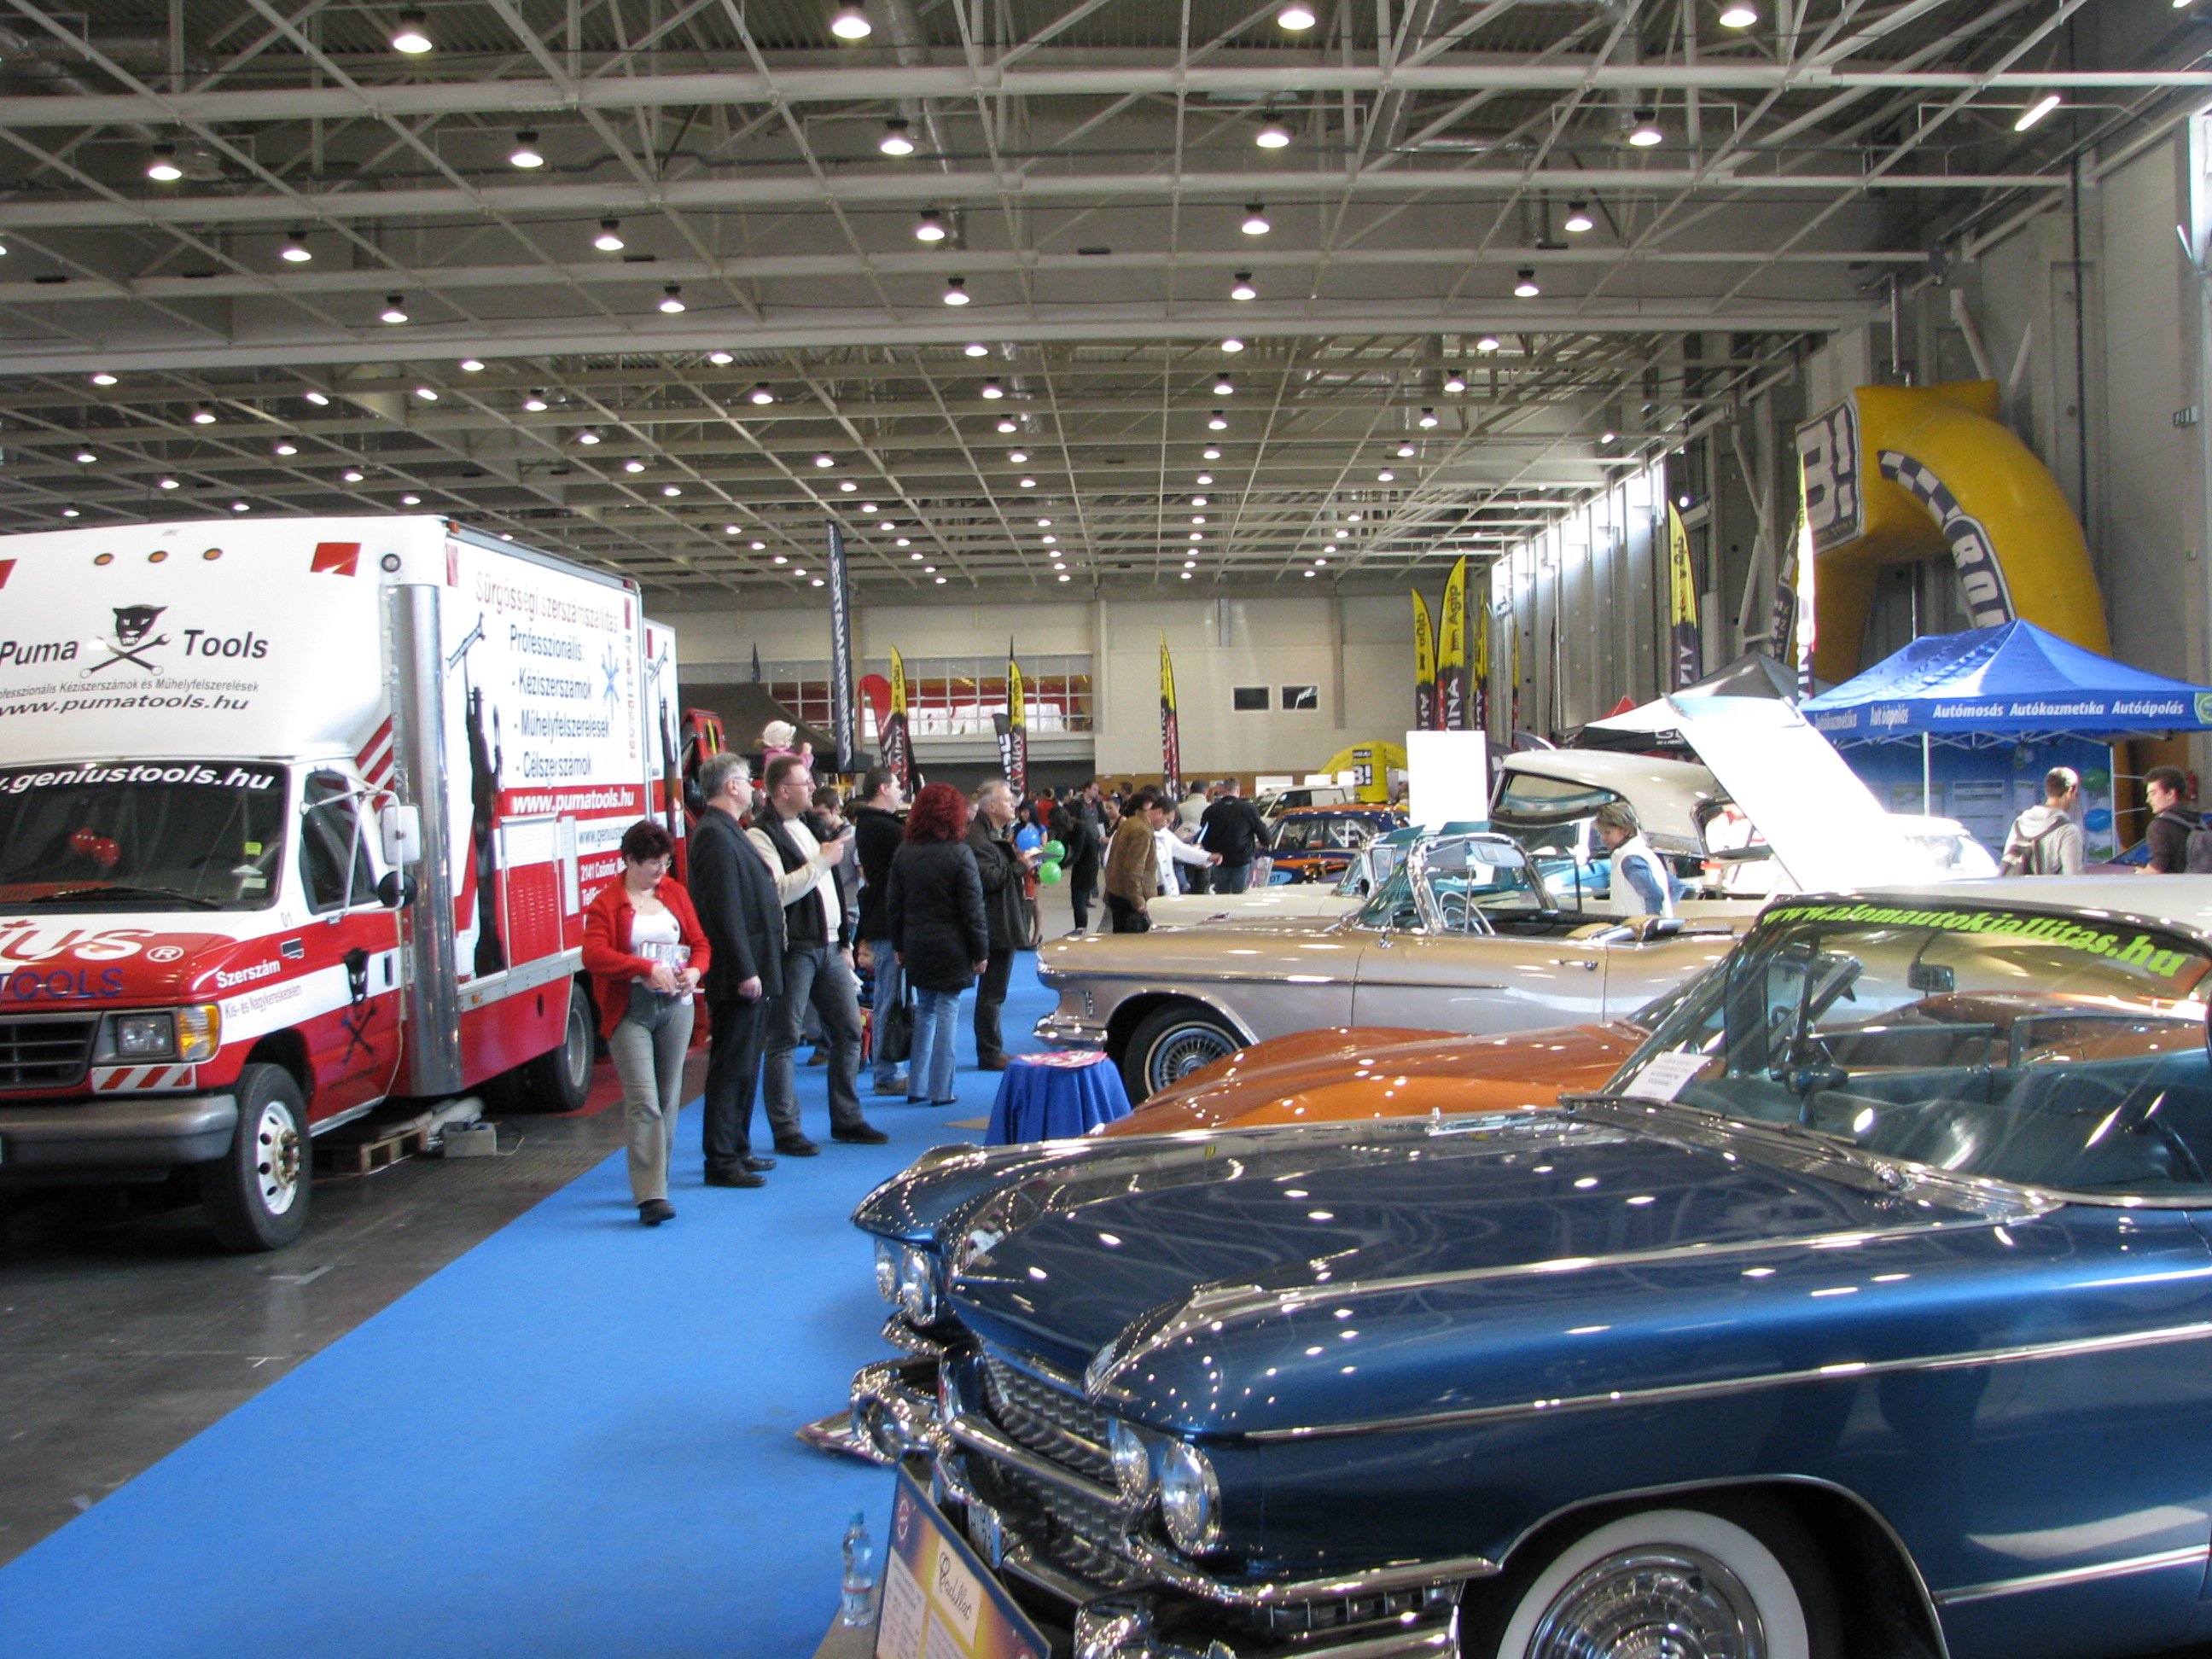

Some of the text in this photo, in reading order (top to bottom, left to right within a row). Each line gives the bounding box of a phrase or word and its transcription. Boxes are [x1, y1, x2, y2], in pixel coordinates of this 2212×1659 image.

[1446, 584, 1462, 626] Agip
[0, 630, 269, 666] Puma Tools
[60, 679, 137, 693] Kéziszerszámok
[141, 679, 153, 690] és
[155, 678, 259, 694] Műhelyfelszerelések
[519, 667, 592, 700] Kéziszerszámok
[521, 709, 610, 744] Műhelyfelszerelések
[1933, 701, 2185, 719] Autómosás Autókozmetika Autóápolás
[523, 749, 592, 779] Célszerszámok
[513, 787, 635, 814] www.pumatools.hu
[1761, 903, 2187, 977] www.alomautokiallitas.hu
[215, 958, 282, 989] Szerszám
[939, 1551, 973, 1621] Cadillac
